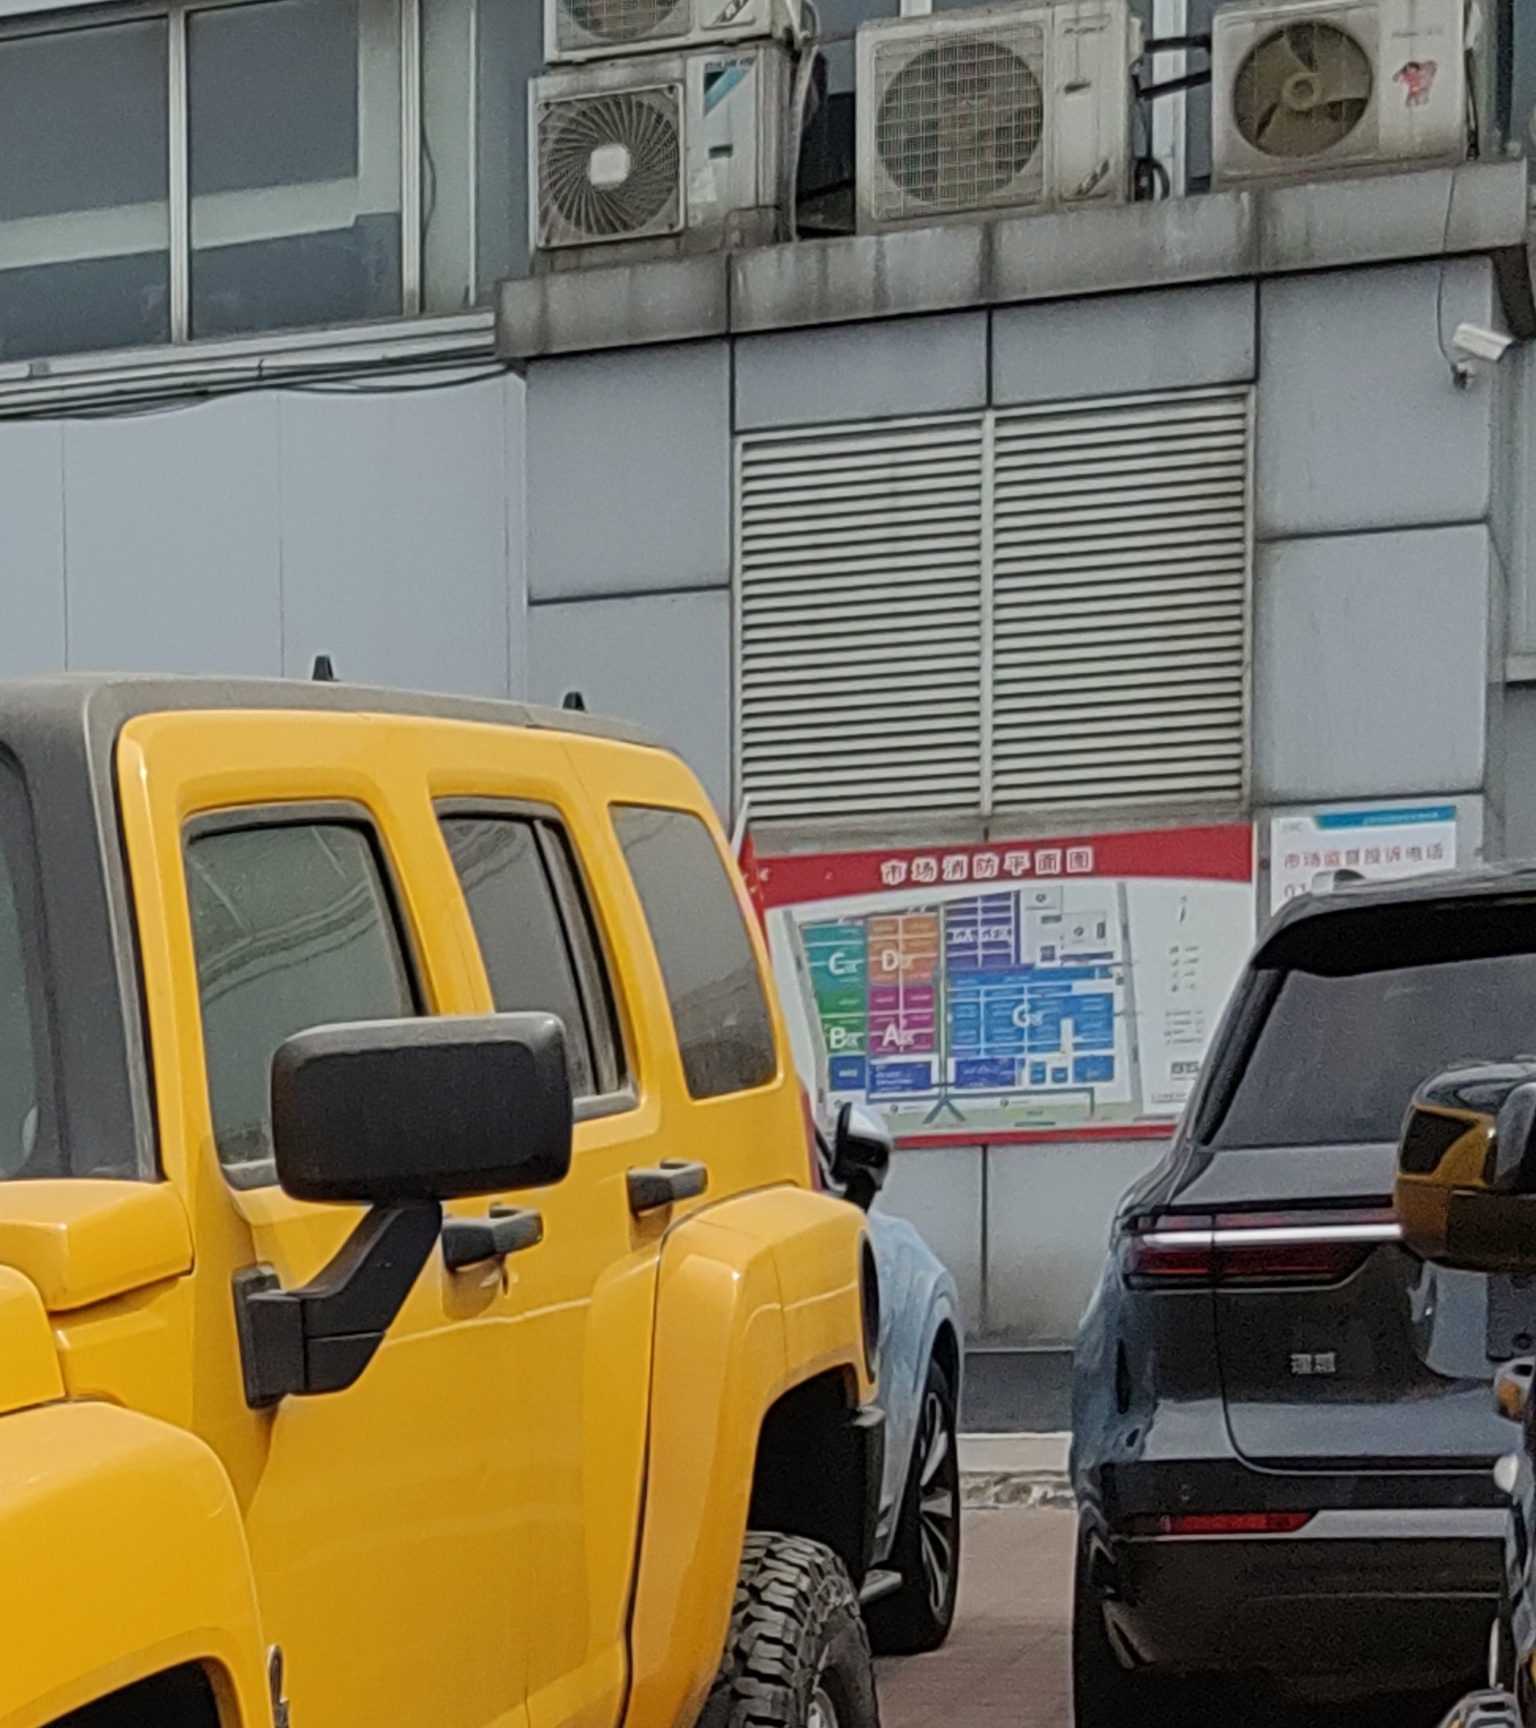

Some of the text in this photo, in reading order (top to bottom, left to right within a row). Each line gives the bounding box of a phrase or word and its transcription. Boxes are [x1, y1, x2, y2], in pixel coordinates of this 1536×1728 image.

[881, 846, 1094, 886] 市场消防平面图
